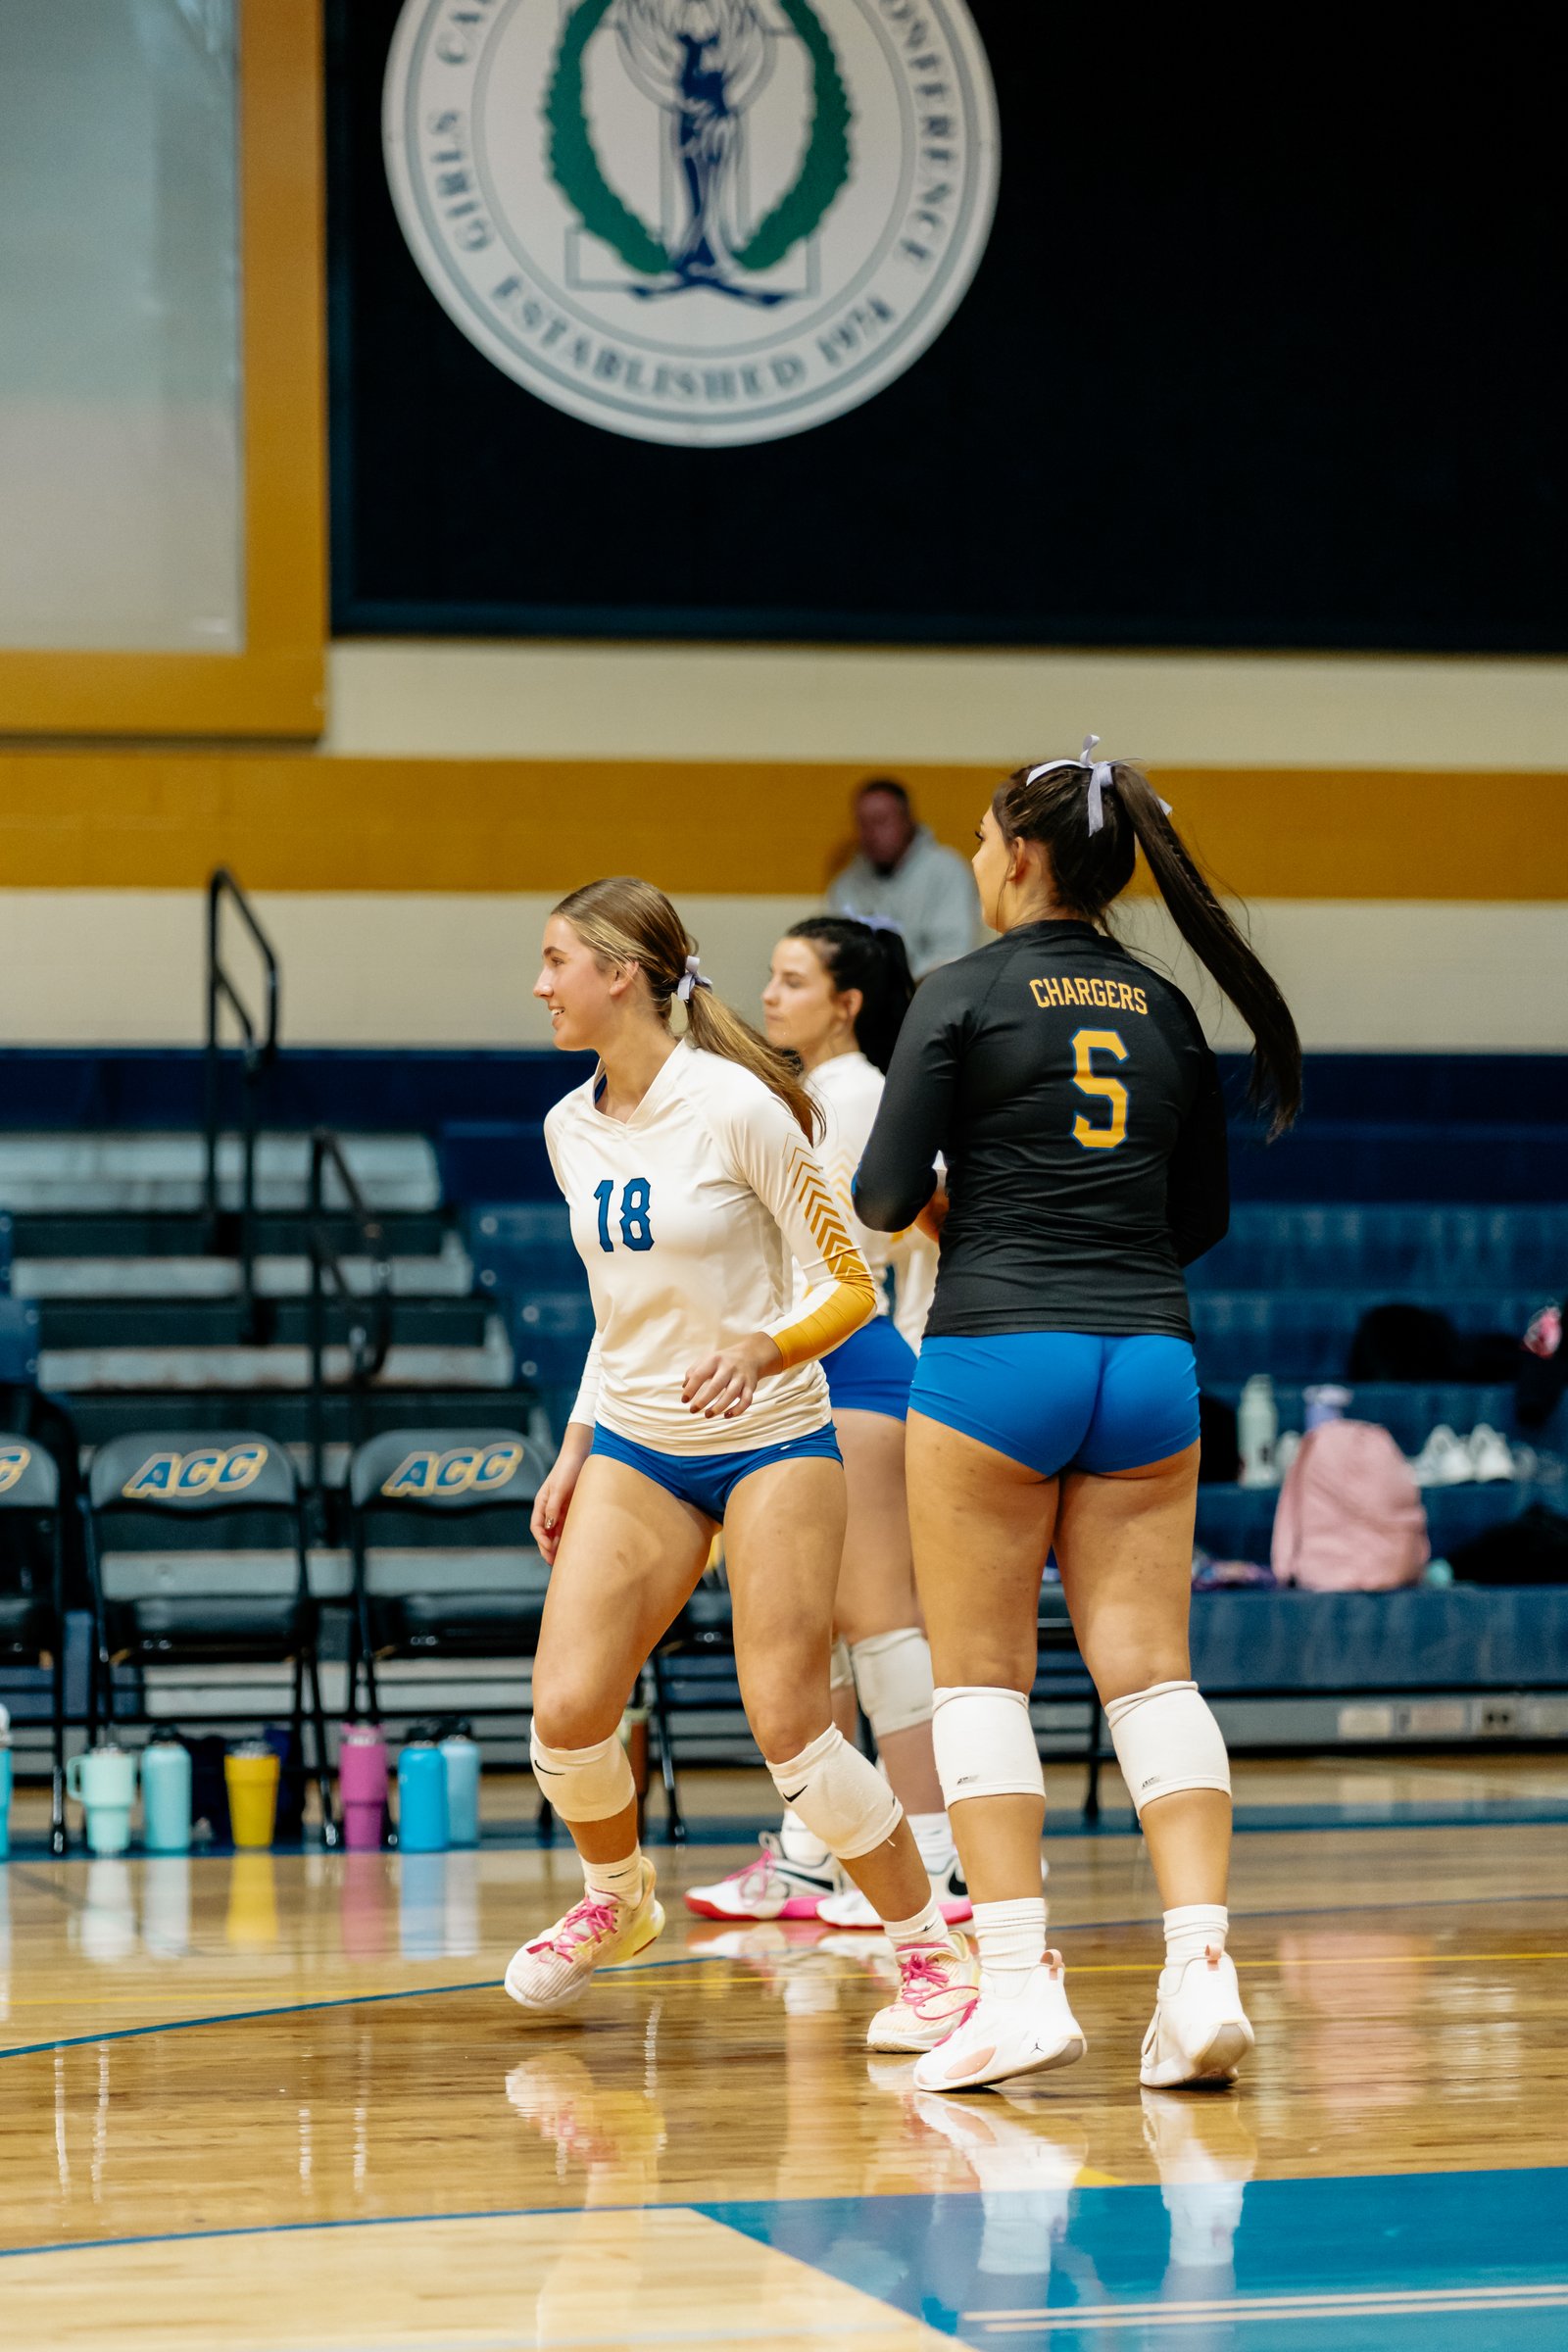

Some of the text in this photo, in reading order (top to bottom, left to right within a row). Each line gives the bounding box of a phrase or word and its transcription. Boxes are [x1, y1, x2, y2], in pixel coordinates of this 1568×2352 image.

[429, 108, 493, 253] GIRLS
[491, 275, 808, 404] ESTABLISHED
[1029, 977, 1149, 1015] CHARGERS
[1069, 1027, 1130, 1152] 5
[593, 1177, 656, 1252] 18
[122, 1443, 270, 1498] ACC
[380, 1442, 524, 1497] ACC
